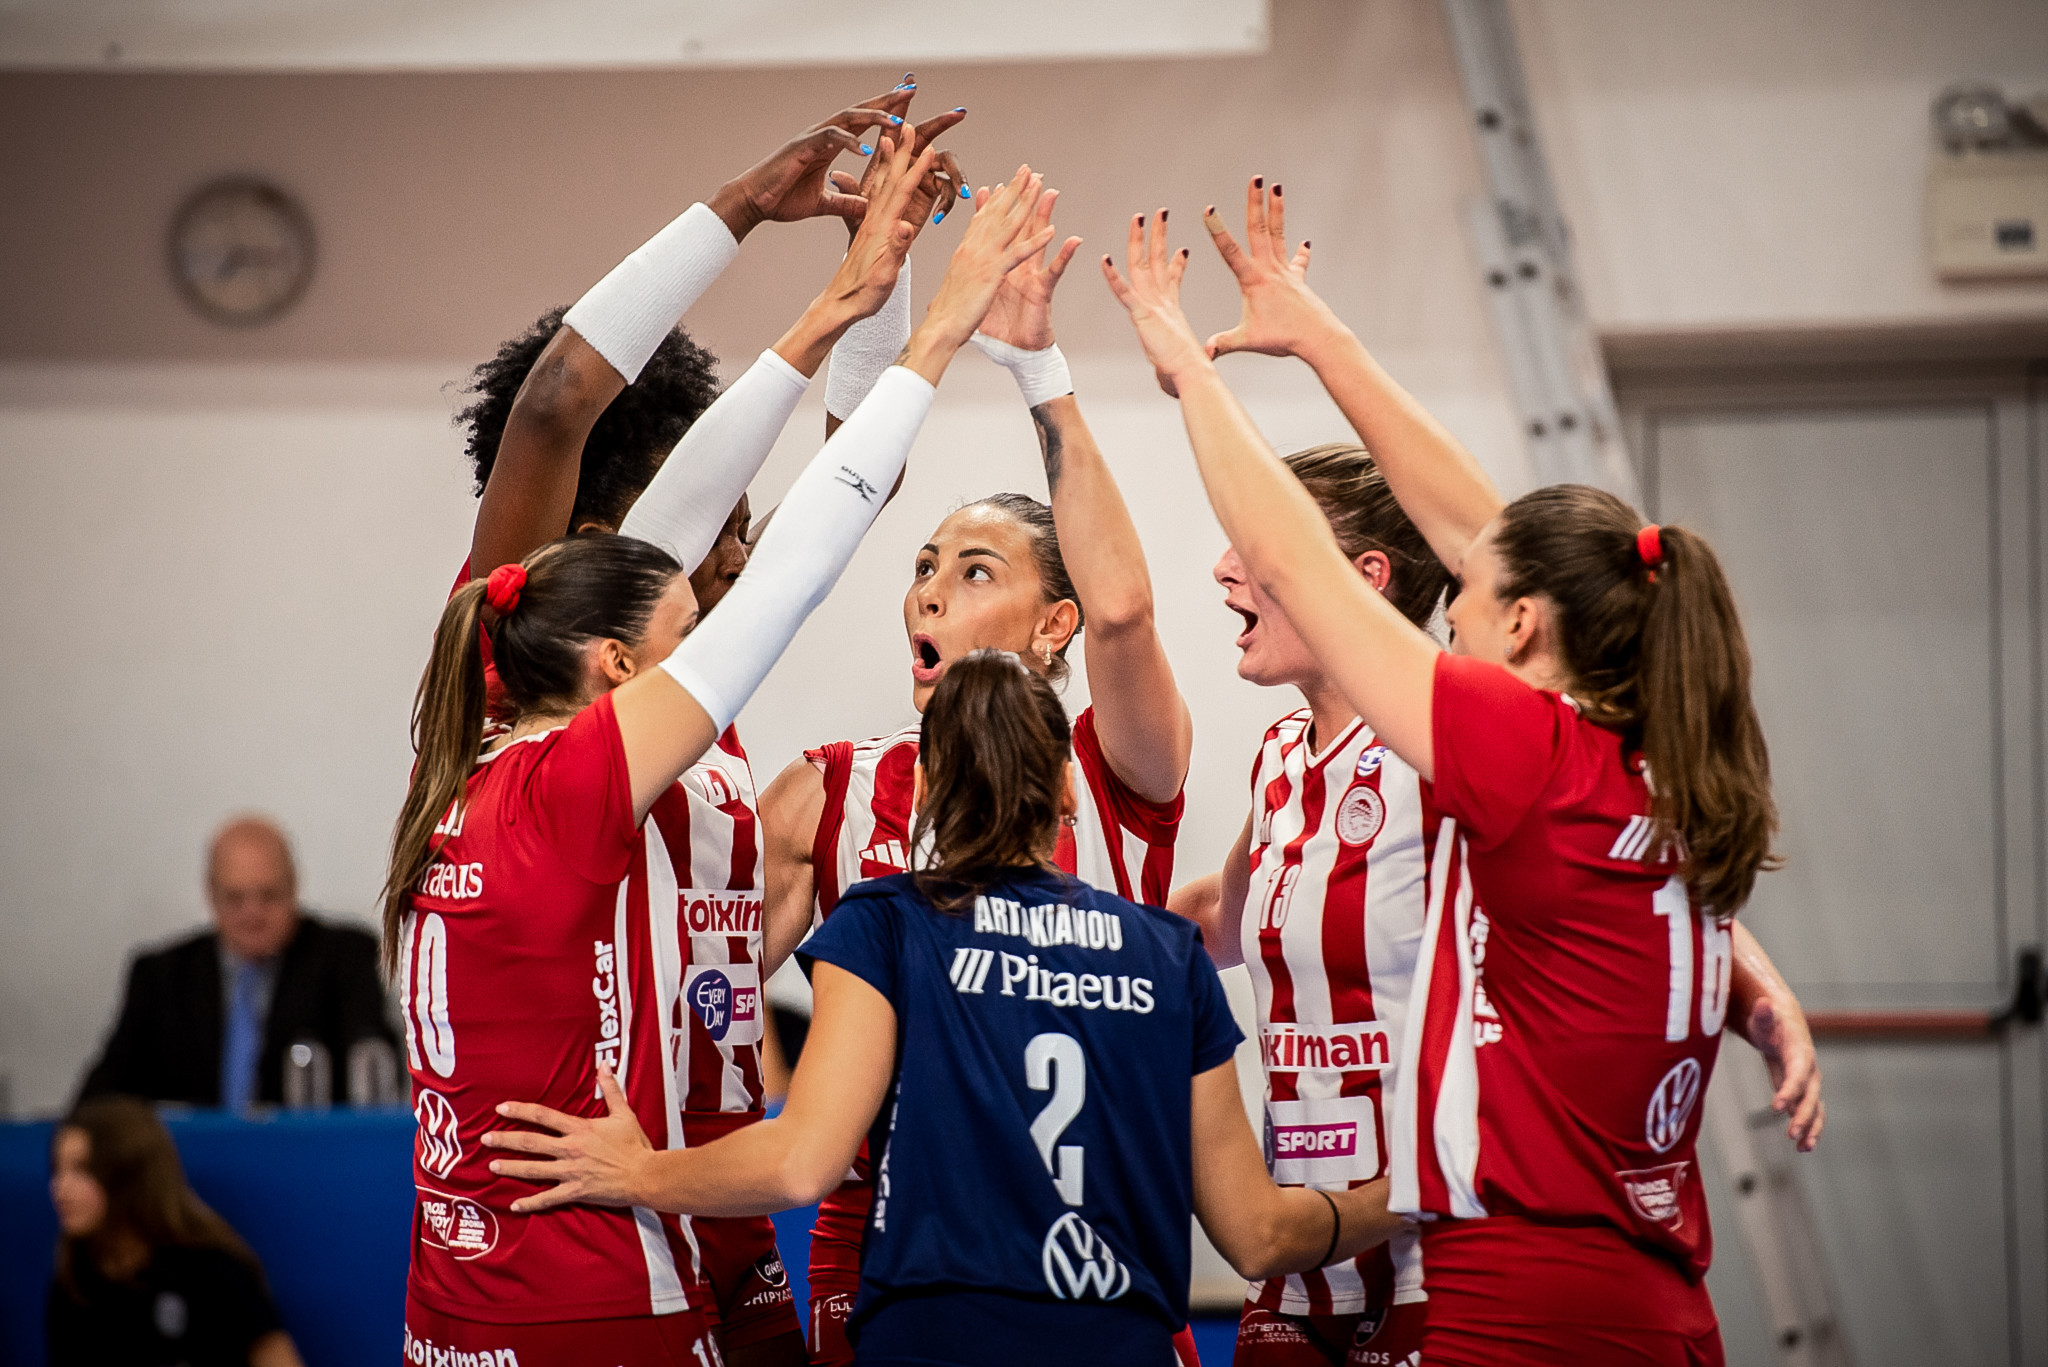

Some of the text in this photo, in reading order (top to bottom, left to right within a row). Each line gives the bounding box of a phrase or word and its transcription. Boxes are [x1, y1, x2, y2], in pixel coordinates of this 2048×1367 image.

[418, 862, 483, 899] raeus
[1259, 863, 1302, 930] 13
[402, 909, 456, 1079] 10
[697, 979, 726, 1007] EVERY
[1000, 951, 1154, 1014] Piraeus
[705, 1004, 725, 1030] DAY
[735, 994, 755, 1014] SP
[1025, 1033, 1086, 1206] 2
[1277, 1128, 1355, 1152] SPORT
